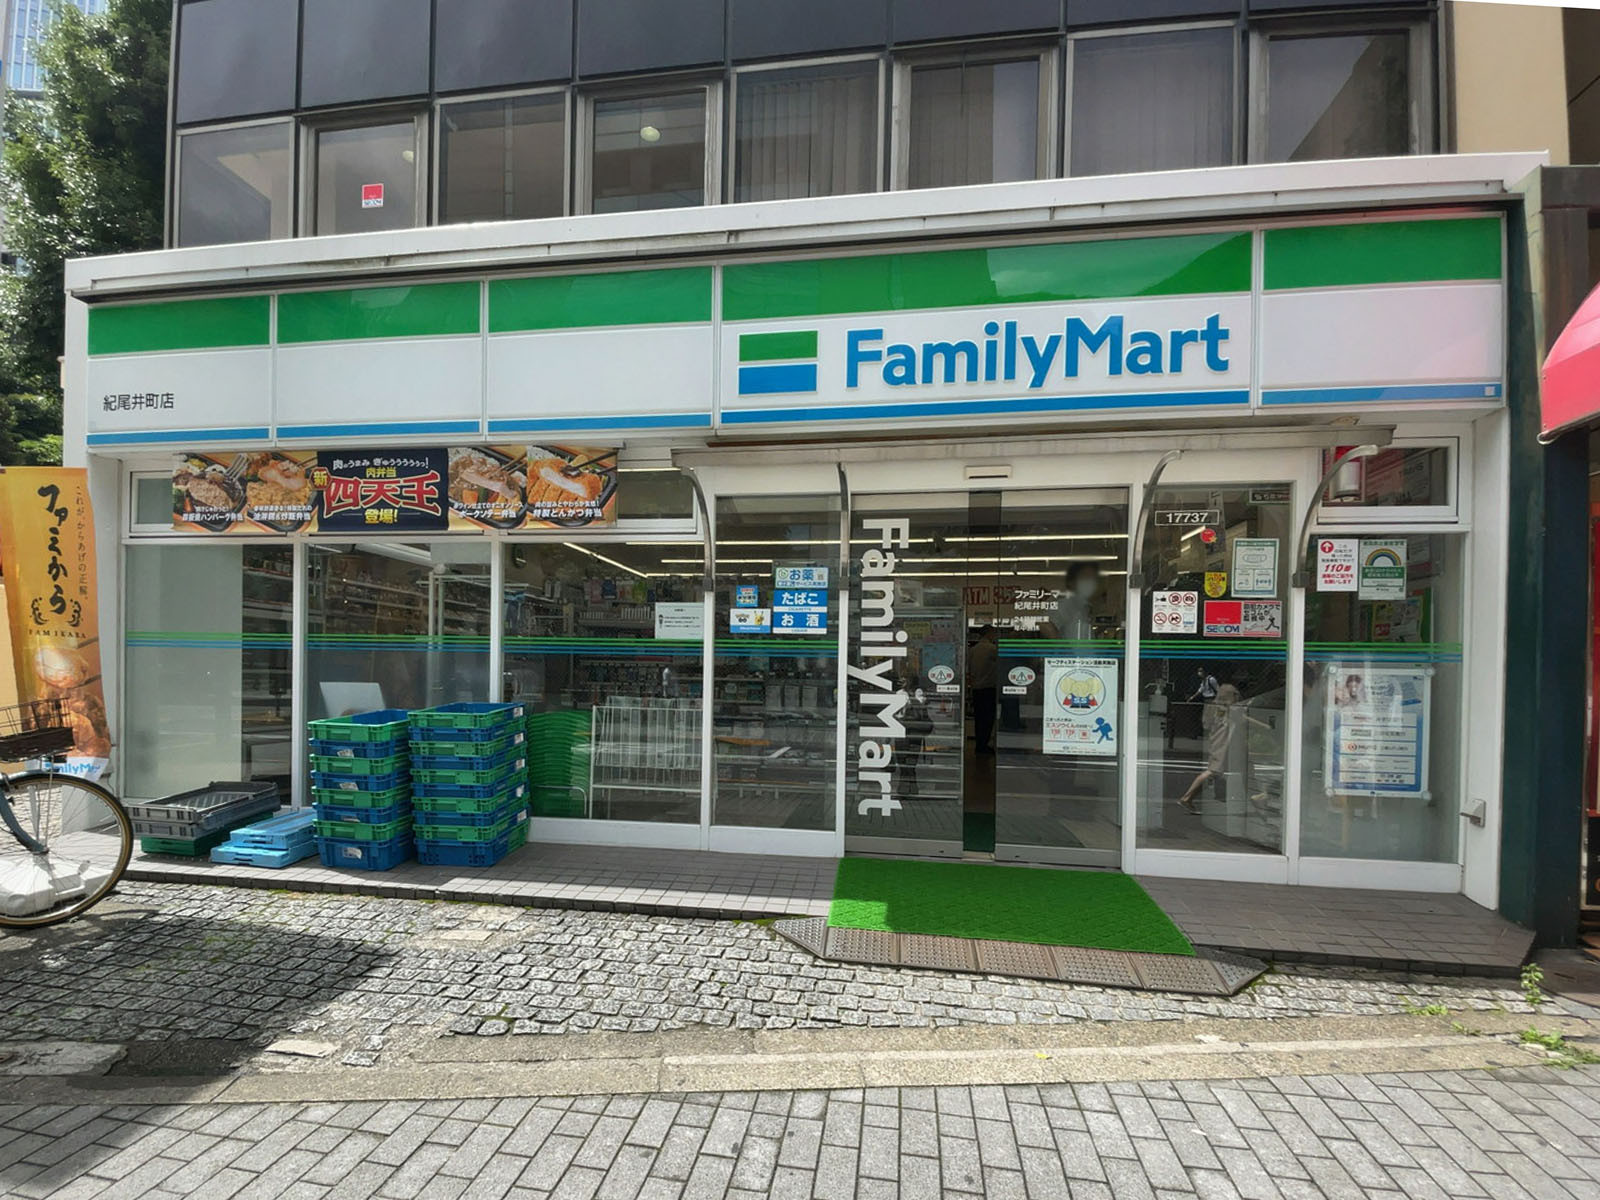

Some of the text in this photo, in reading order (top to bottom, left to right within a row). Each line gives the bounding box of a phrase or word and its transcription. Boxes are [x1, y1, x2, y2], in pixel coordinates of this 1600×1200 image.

[846, 313, 1230, 389] FamilyMart
[103, 392, 174, 411] 紀尾井町店
[333, 459, 370, 470] 肉のうまみ
[313, 470, 328, 487] 新
[366, 467, 397, 478] 肉弁当
[323, 470, 441, 518] 四天王
[364, 508, 398, 525] 登場!
[1166, 512, 1209, 524] 17737
[38, 484, 69, 615] ファミから
[789, 569, 815, 581] お薬
[782, 592, 819, 605] たばこ
[1014, 601, 1059, 610] 紀尾井町店
[781, 613, 819, 627] お酒
[1206, 625, 1240, 633] SECOM
[846, 517, 909, 817] FamilyMart
